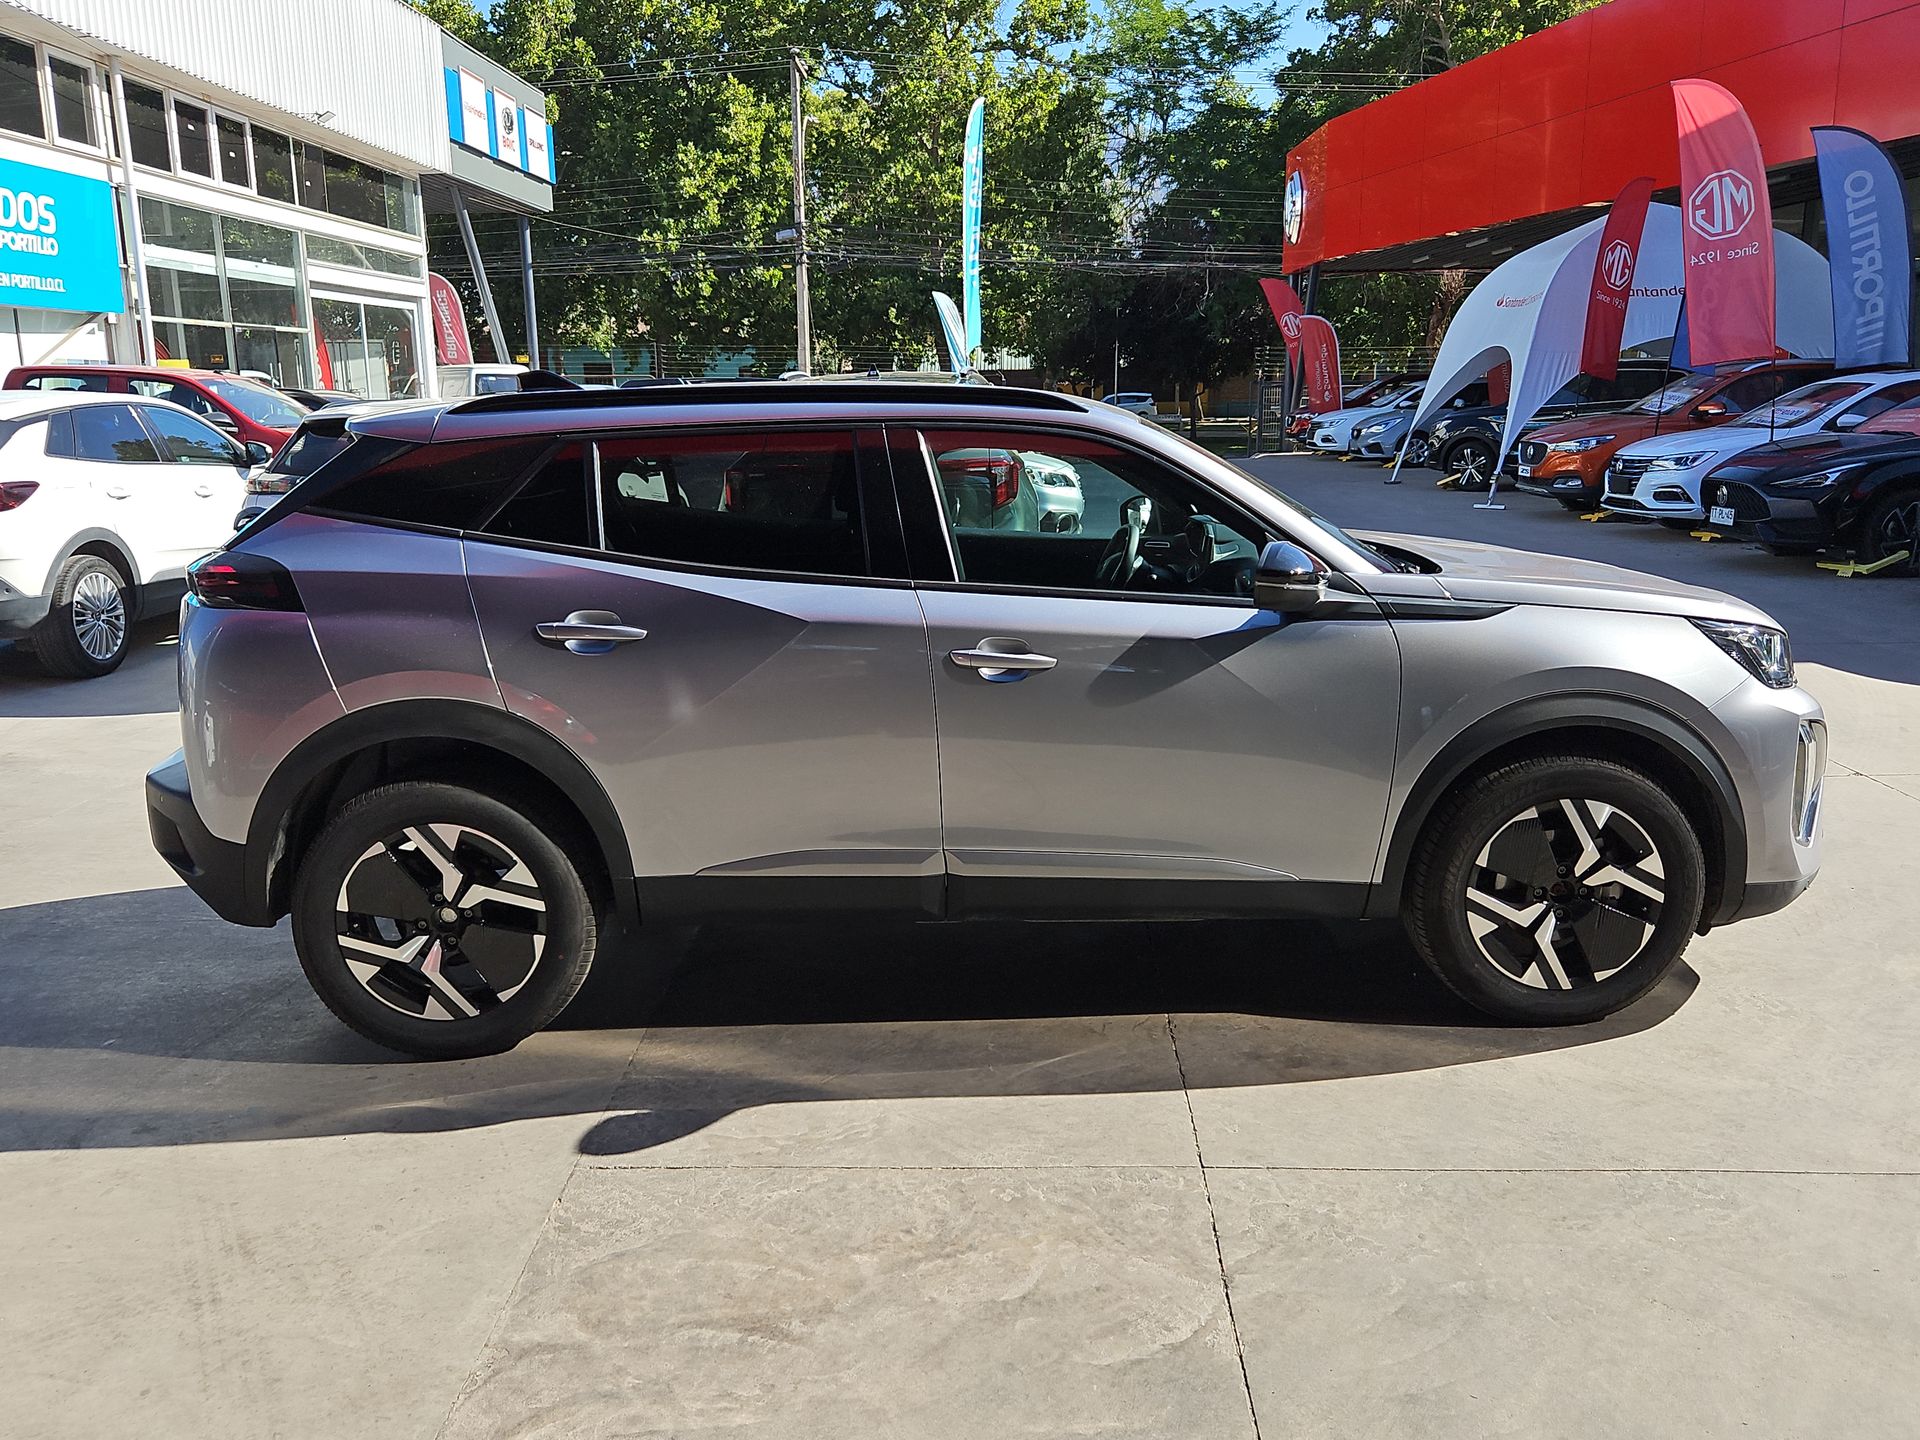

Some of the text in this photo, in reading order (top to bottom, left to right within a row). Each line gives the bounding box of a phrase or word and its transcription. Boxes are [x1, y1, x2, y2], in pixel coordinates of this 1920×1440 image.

[0, 186, 57, 235] DOS
[1604, 244, 1630, 287] MG
[1596, 290, 1611, 304] Since
[1629, 285, 1685, 297] antande
